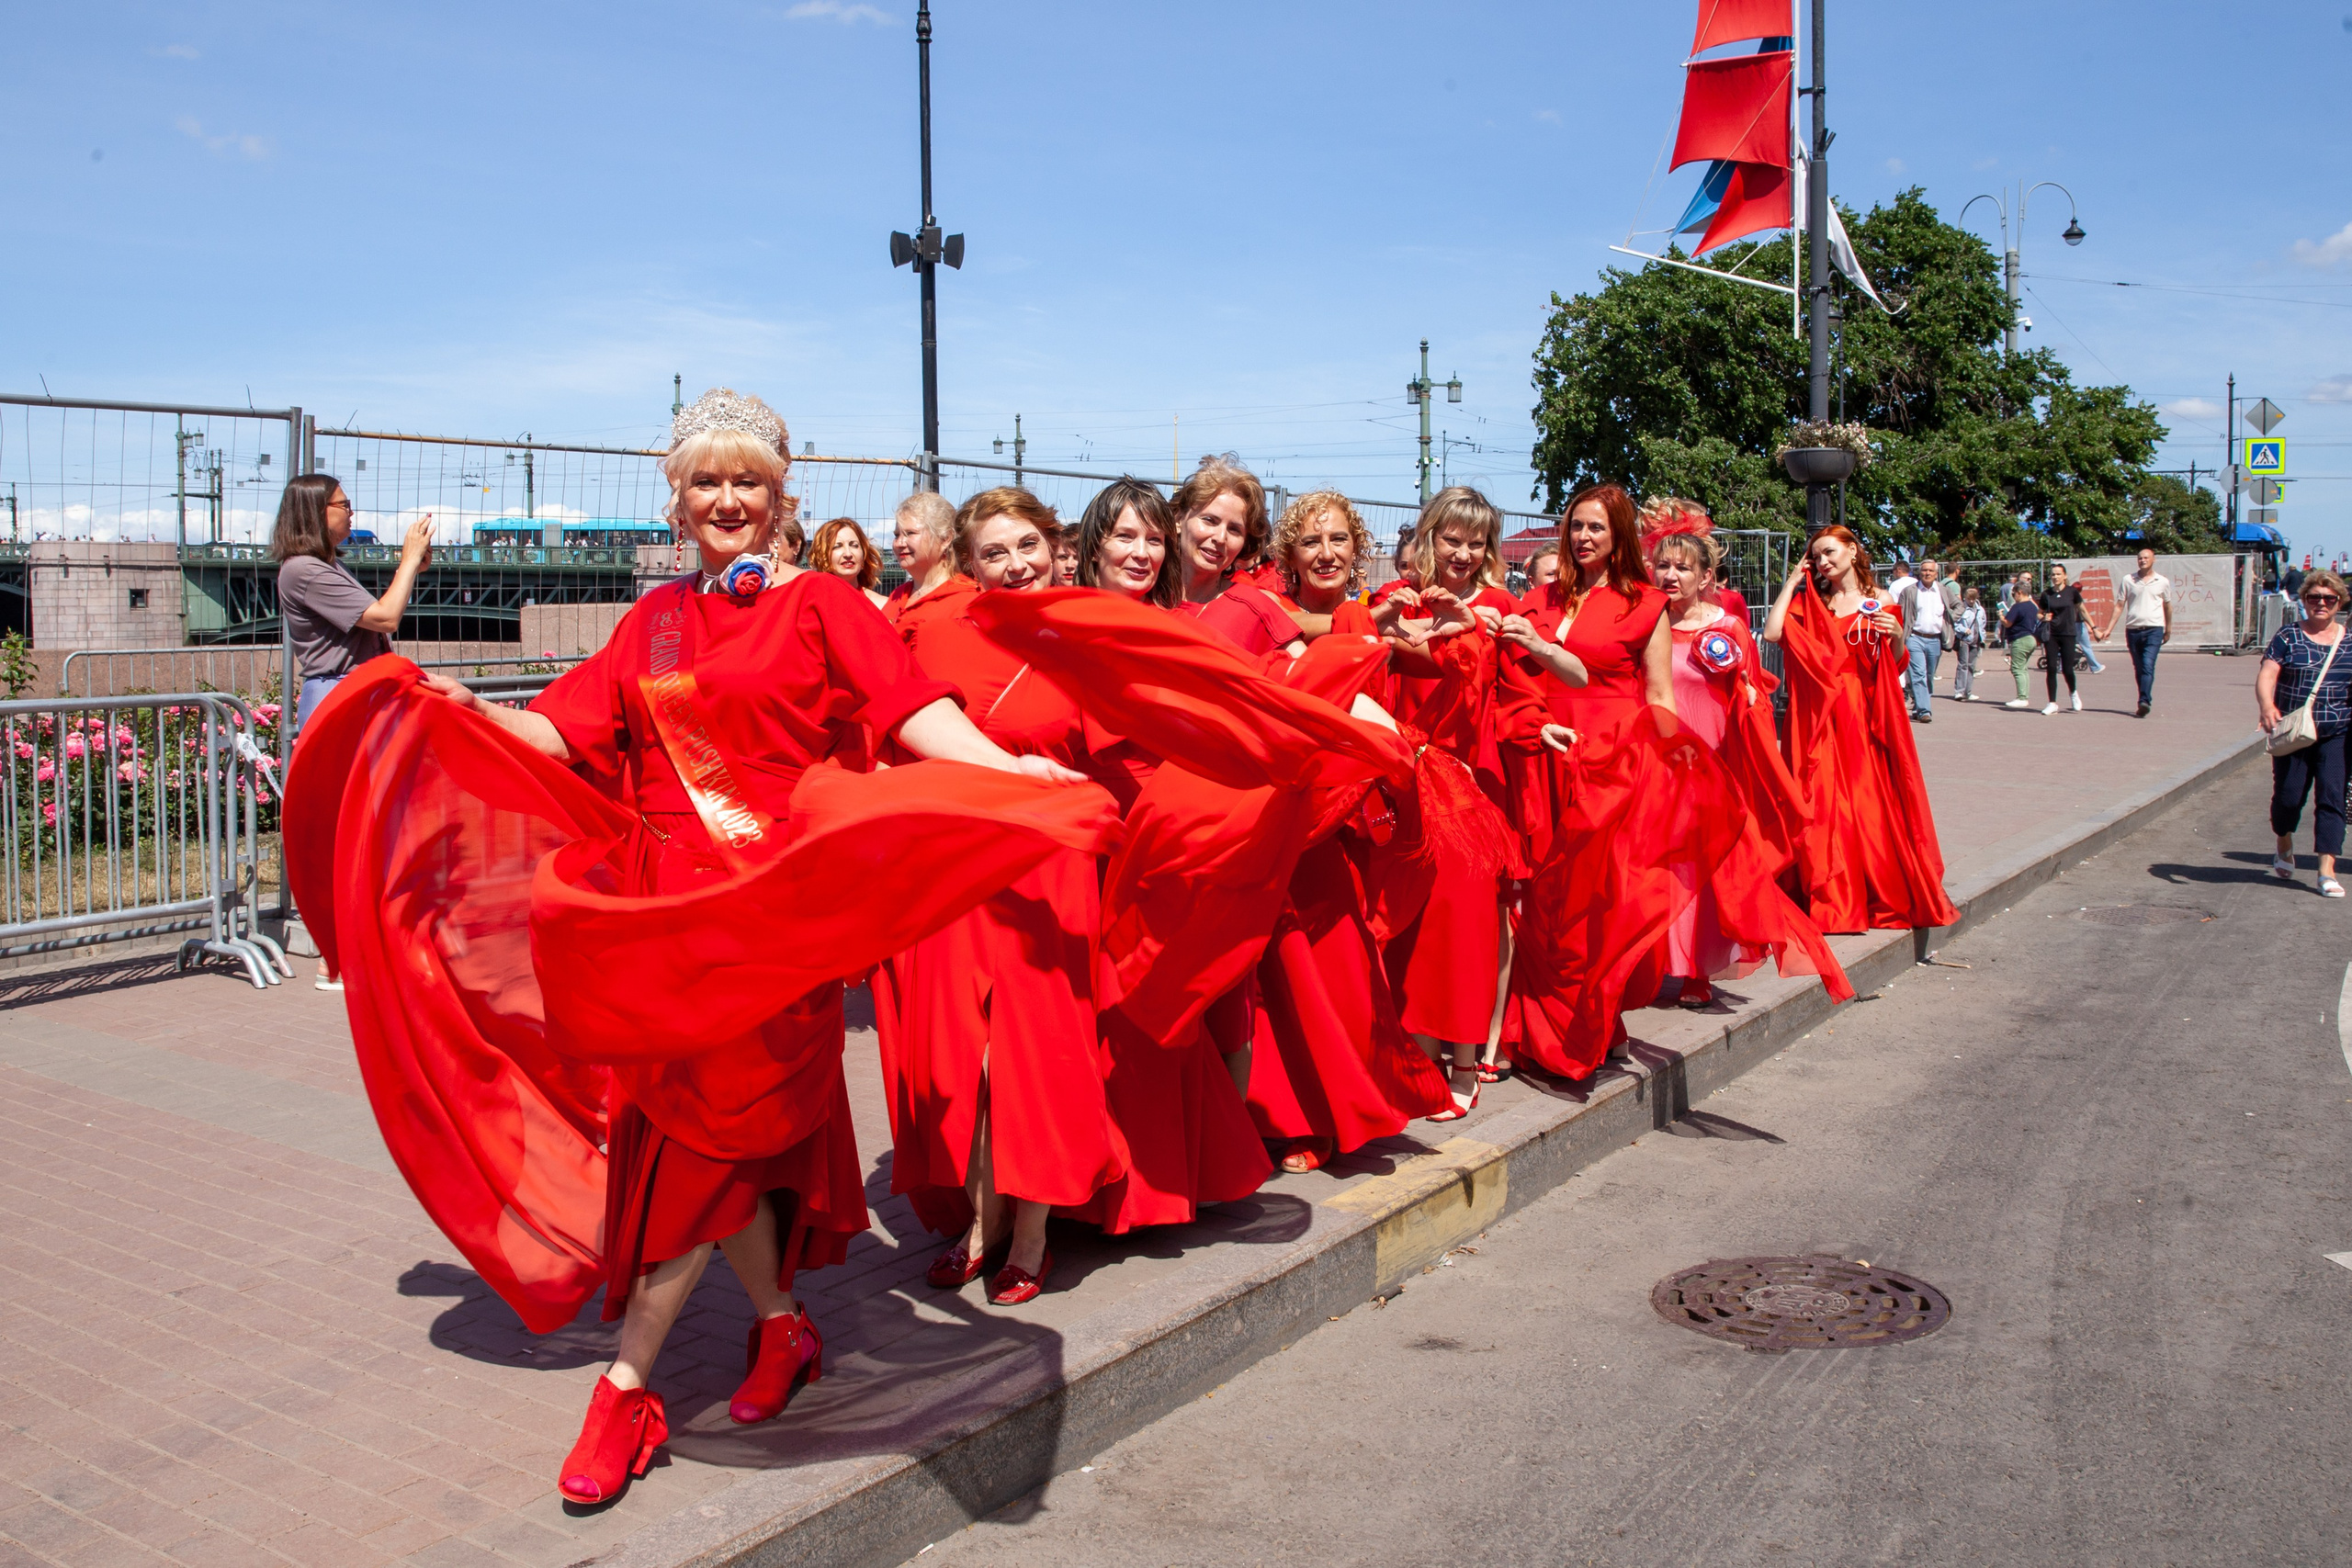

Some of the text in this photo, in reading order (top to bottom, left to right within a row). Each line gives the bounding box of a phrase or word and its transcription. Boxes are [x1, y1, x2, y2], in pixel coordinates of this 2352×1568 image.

[2174, 574, 2203, 587] ЫЕ
[2175, 590, 2215, 603] УСА
[650, 630, 682, 675] GRAND
[650, 671, 693, 733] QUEEN
[680, 725, 741, 809] PUSHKIN
[717, 800, 763, 849] 2023
